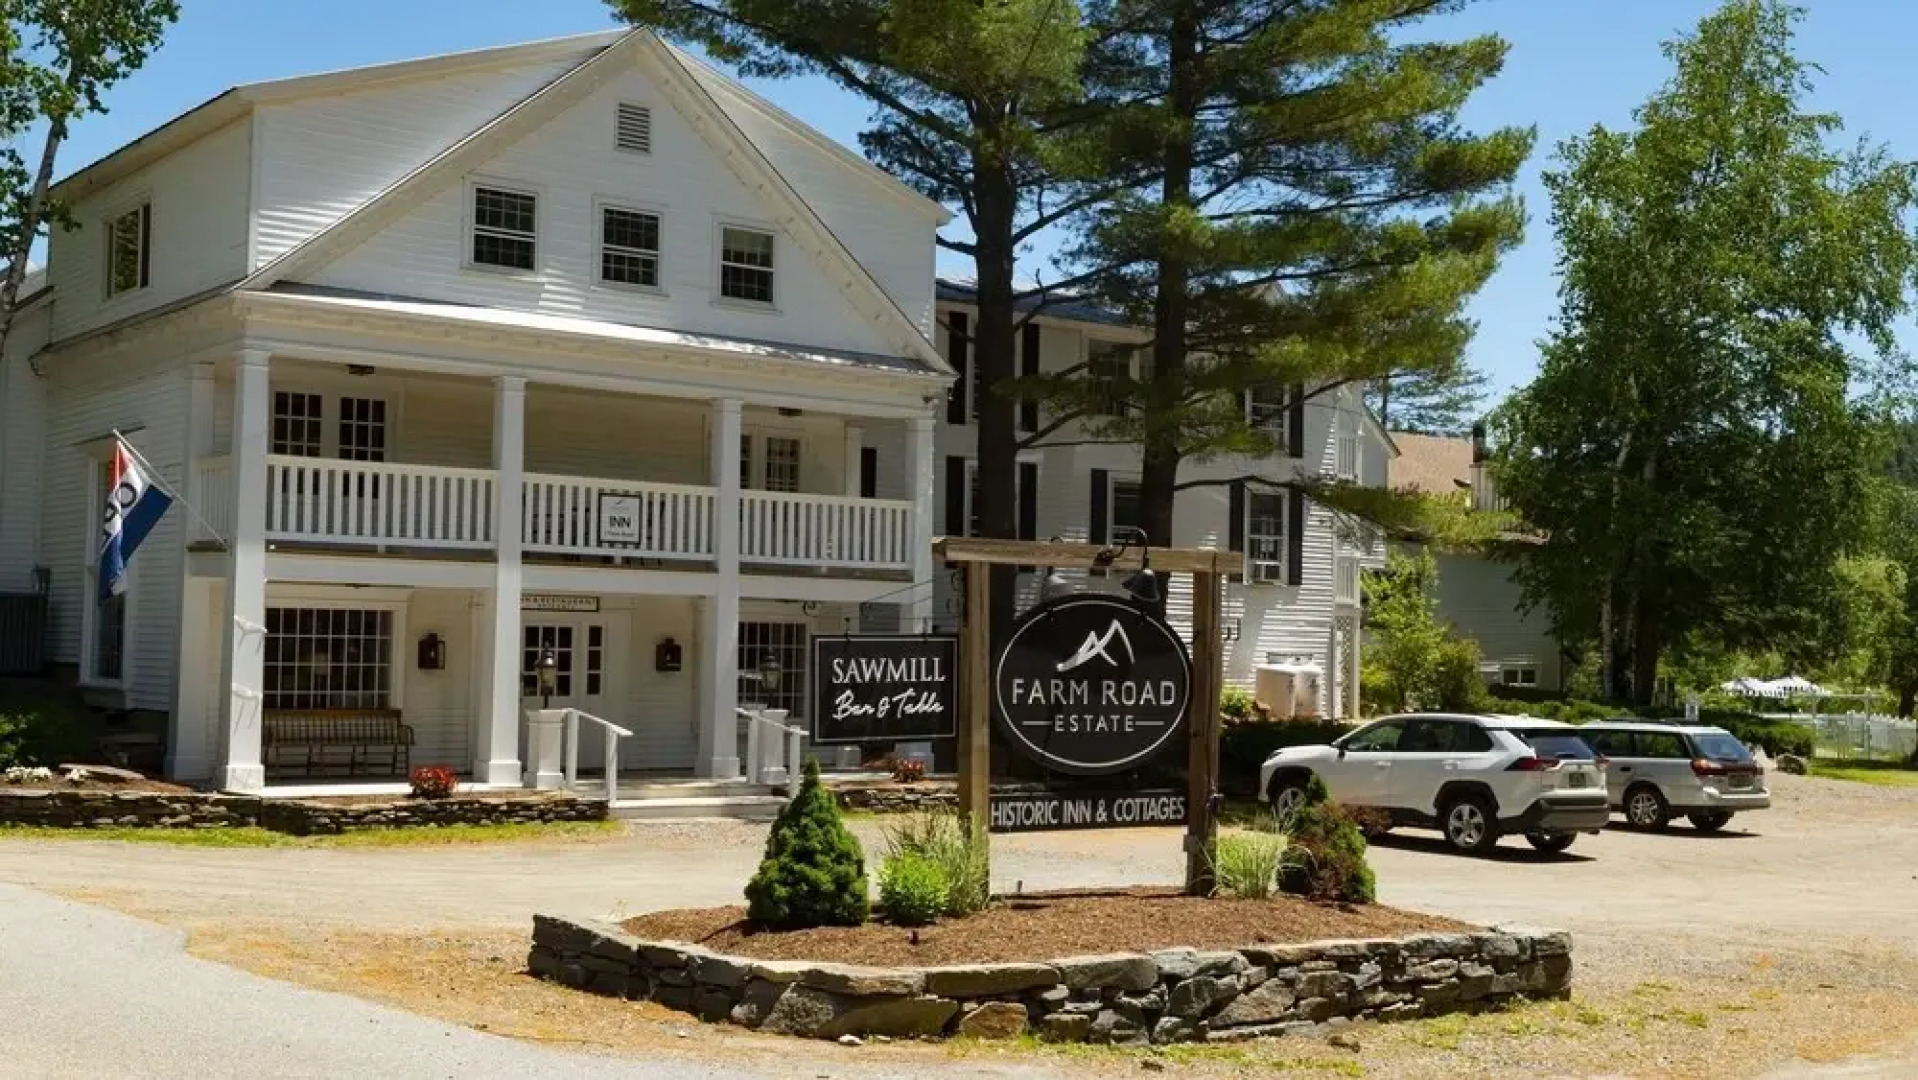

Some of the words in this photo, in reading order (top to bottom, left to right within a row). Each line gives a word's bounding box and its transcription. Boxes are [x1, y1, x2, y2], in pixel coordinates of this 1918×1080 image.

[609, 515, 632, 528] INN
[831, 657, 946, 684] SAWMILL
[831, 688, 875, 720] Bar
[891, 687, 945, 719] Table
[1011, 678, 1089, 705] FARM
[1102, 680, 1176, 706] ROAD
[1054, 714, 1135, 732] ESTATE
[990, 799, 1060, 828] HISTORIC
[1062, 798, 1092, 824] INN
[1096, 797, 1108, 823] &
[1113, 796, 1186, 822] COTTAGES
